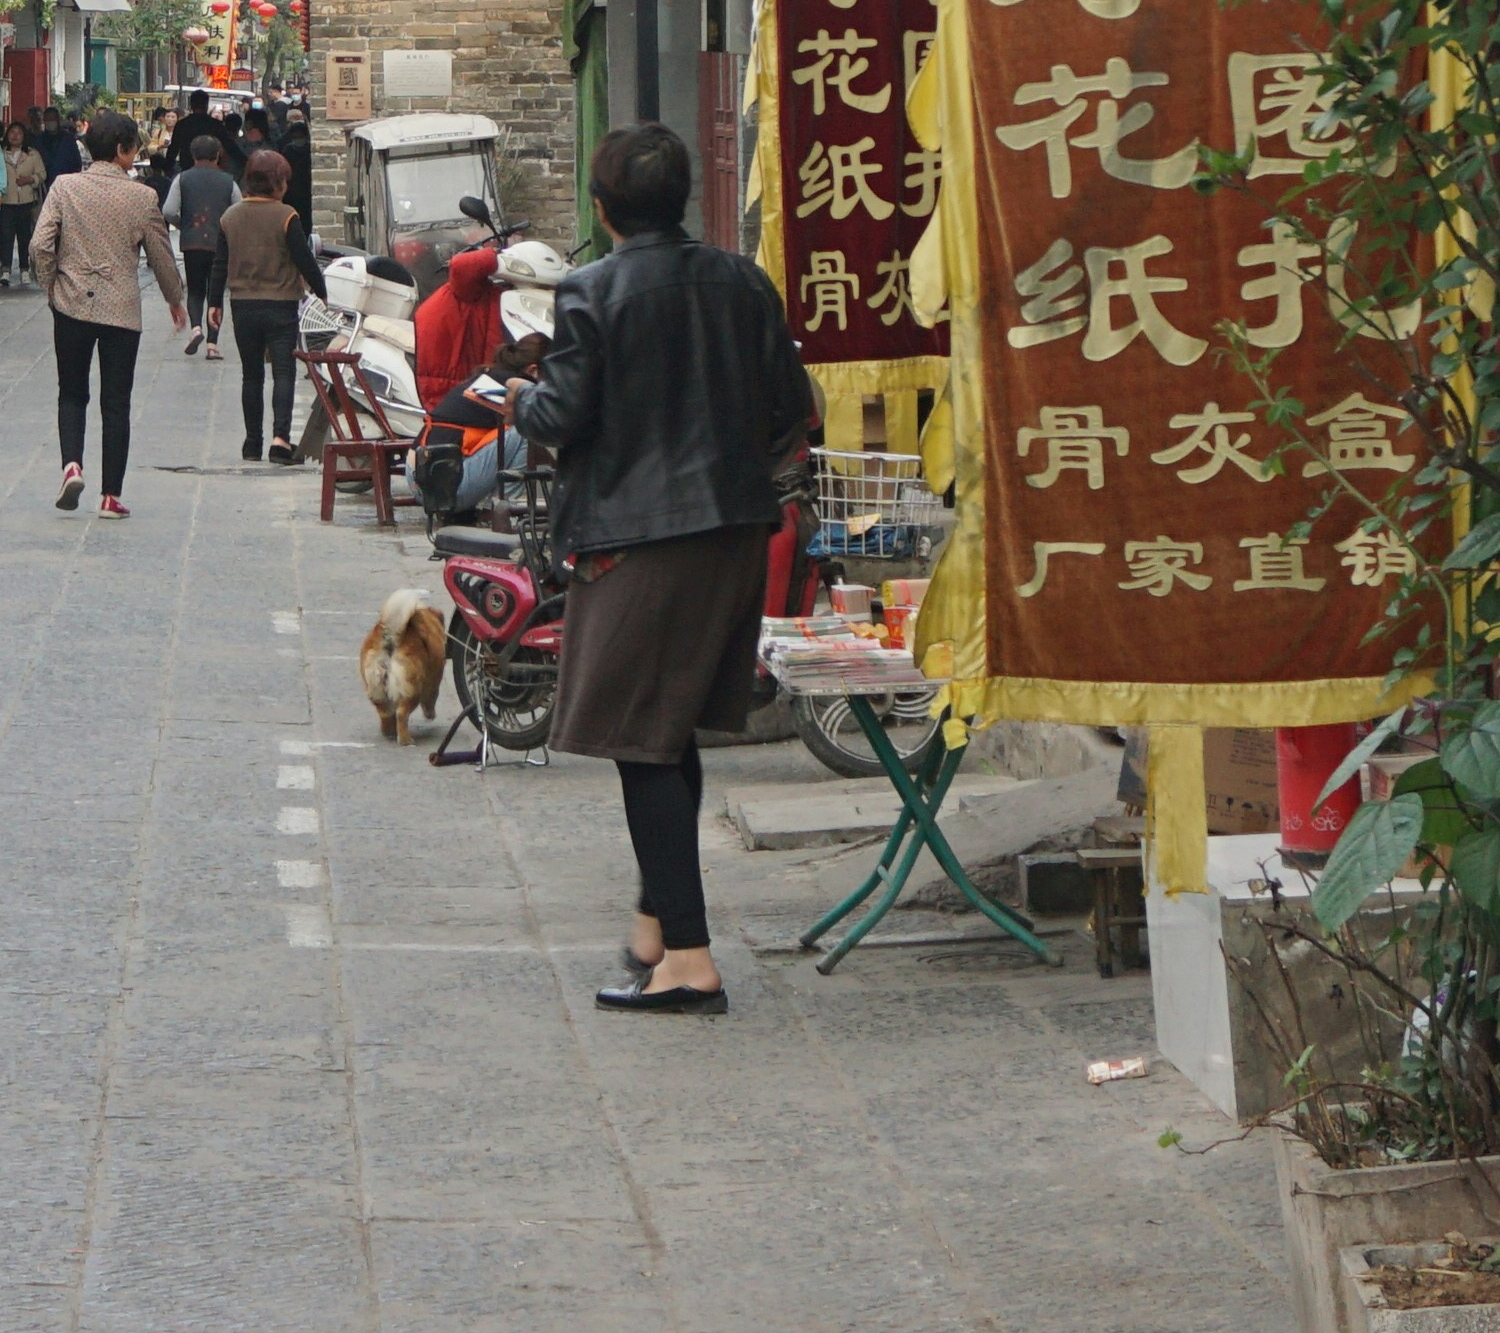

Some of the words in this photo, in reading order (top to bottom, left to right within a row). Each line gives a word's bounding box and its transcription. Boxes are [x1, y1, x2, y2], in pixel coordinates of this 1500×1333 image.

[996, 51, 1398, 198] 花圈
[801, 249, 950, 331] 骨灰
[1007, 217, 1421, 366] 纸扎
[1017, 392, 1416, 490] 骨灰盒
[1015, 527, 1418, 598] 厂家直销
